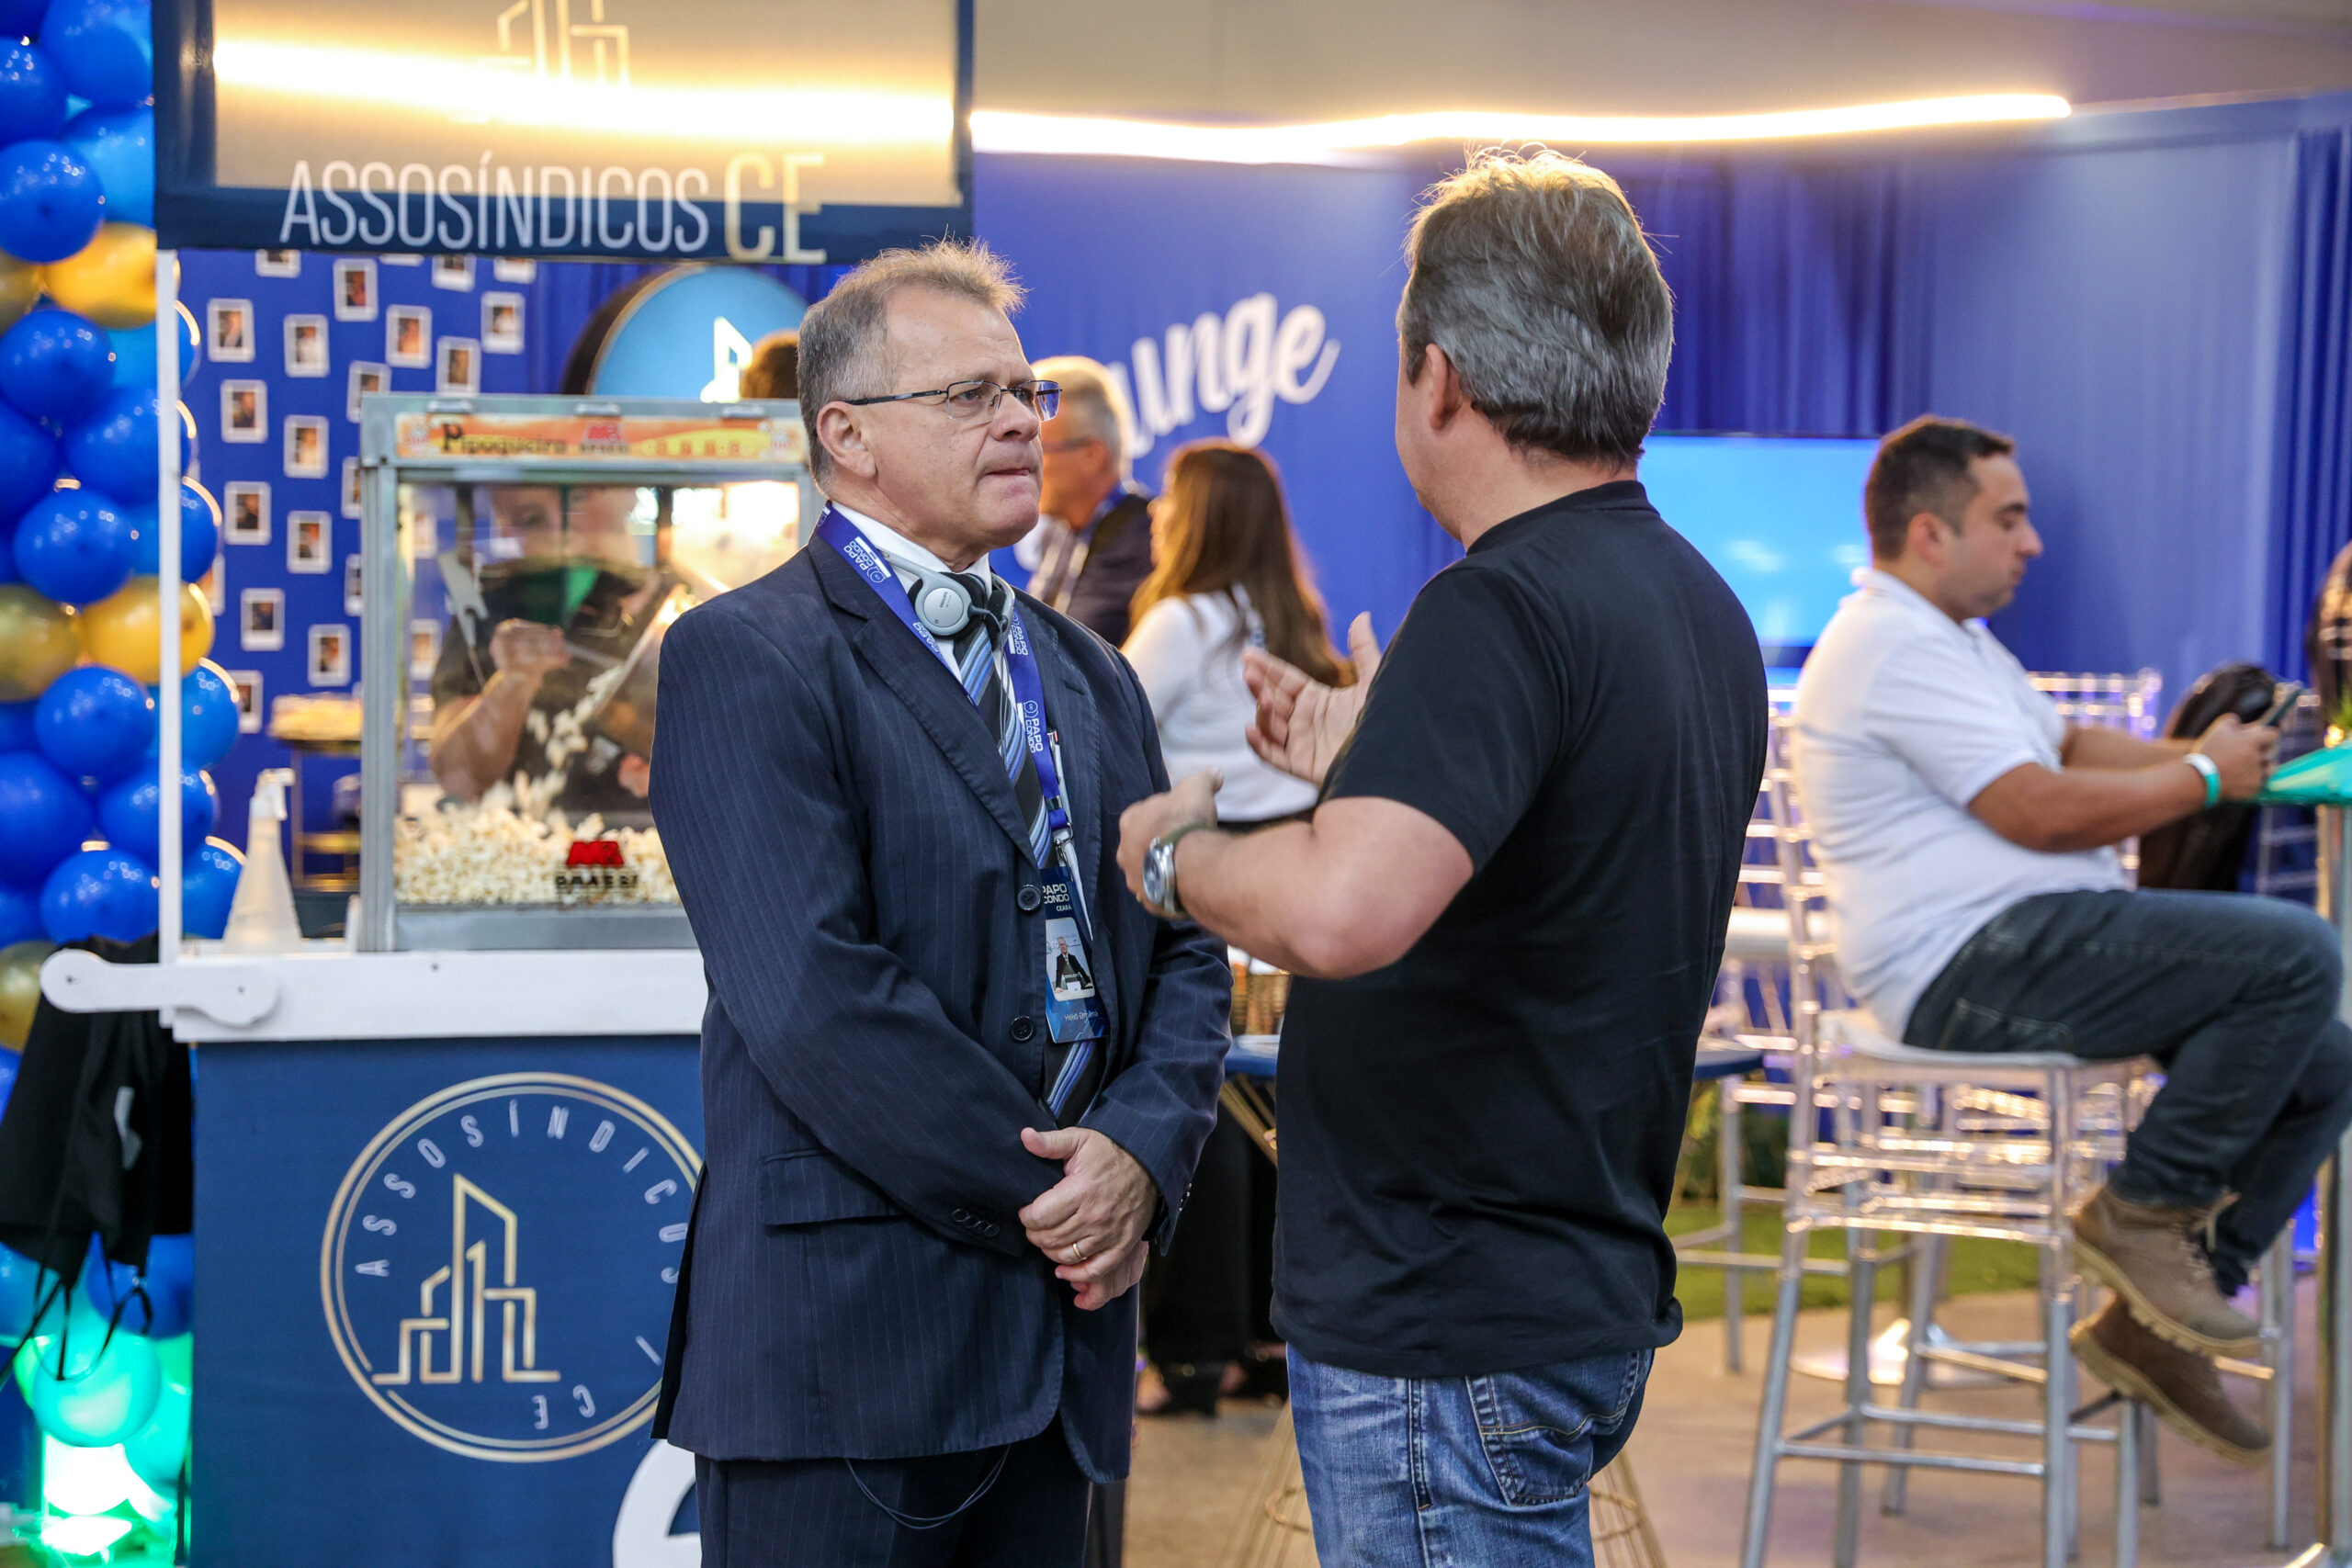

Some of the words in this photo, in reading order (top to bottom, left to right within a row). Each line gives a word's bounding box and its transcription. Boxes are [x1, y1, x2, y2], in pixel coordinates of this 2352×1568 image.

[278, 149, 710, 254] ASSOSÍNDICOS
[724, 151, 827, 265] CE
[1107, 291, 1342, 458] unge
[843, 545, 870, 571] PAPO
[849, 540, 875, 567] CONDO
[1011, 625, 1023, 655] CONDO
[1016, 626, 1029, 656] PAPO
[1025, 719, 1036, 753] CONDO
[1032, 717, 1044, 752] PAPO
